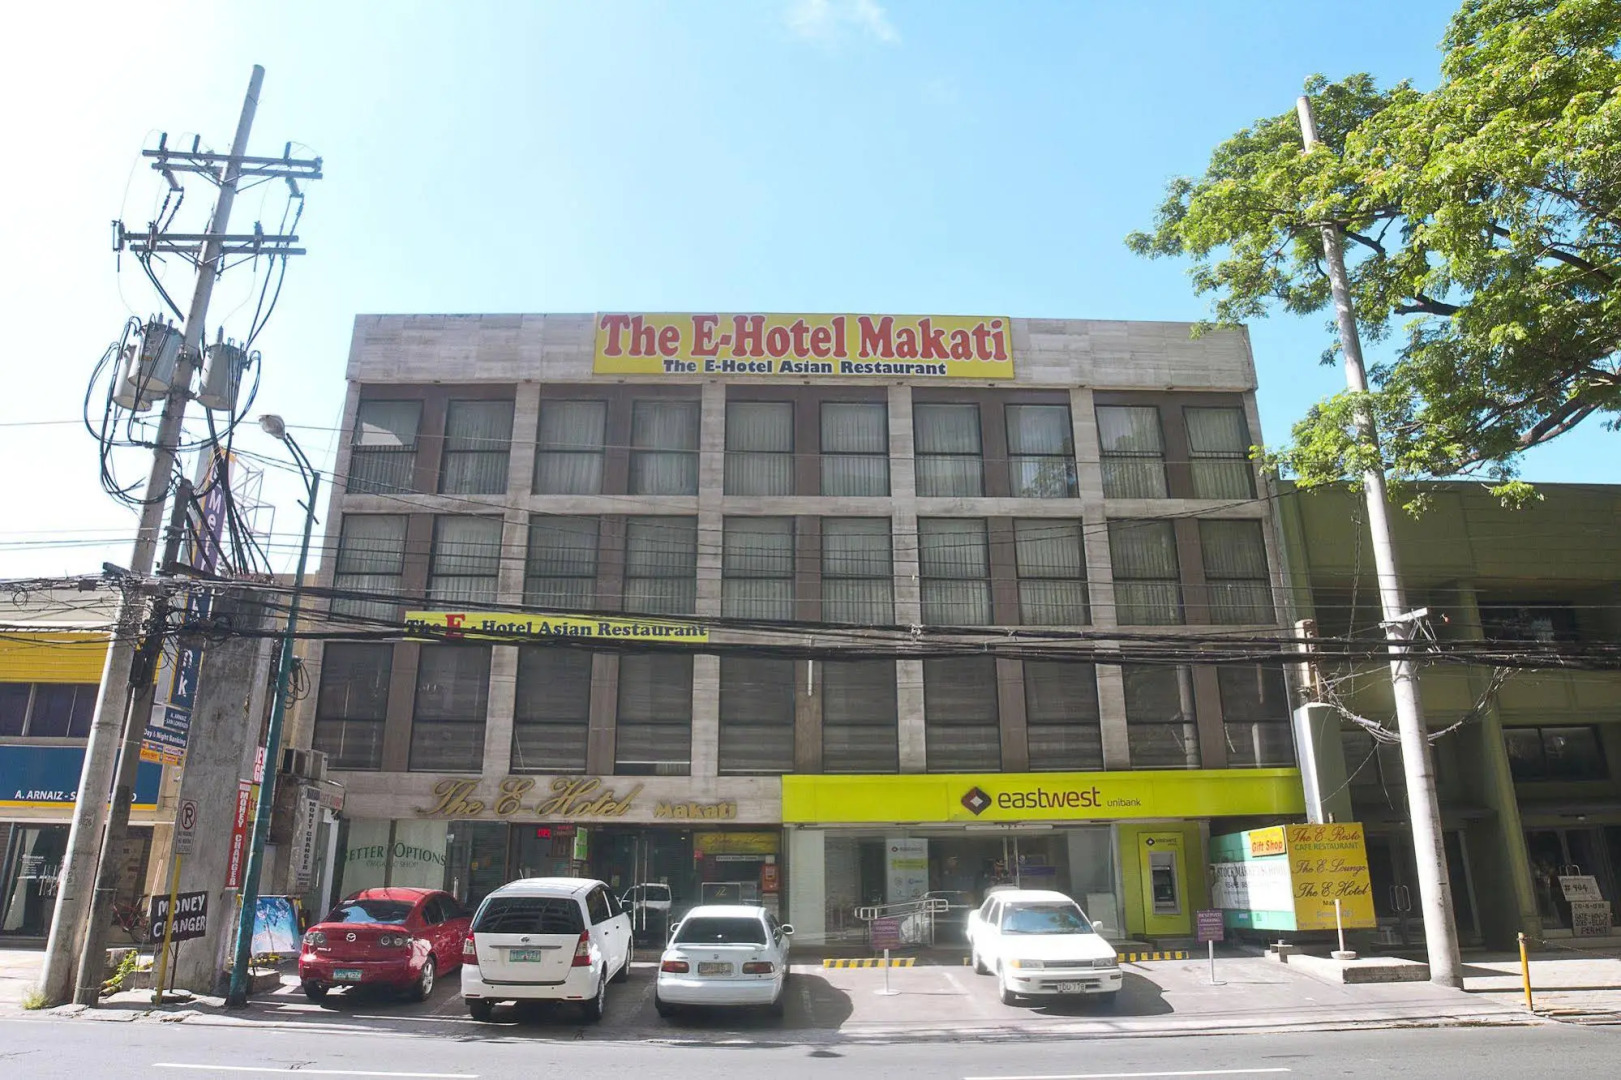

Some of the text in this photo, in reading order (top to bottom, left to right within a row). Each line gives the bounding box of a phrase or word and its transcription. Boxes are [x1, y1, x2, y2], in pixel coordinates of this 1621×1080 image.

[601, 313, 1008, 361] The E-Hotel Makati
[663, 359, 947, 376] The E-Hotel Asian Restaurant
[404, 620, 441, 633] The
[537, 621, 593, 637] Asian
[597, 622, 708, 638] Restaurant
[143, 728, 153, 738] Day
[157, 730, 169, 742] Night
[169, 733, 187, 747] Banking
[14, 790, 25, 800] A.
[26, 790, 63, 800] ARNAIZ
[416, 777, 485, 817] The
[653, 801, 738, 819] Makati
[998, 786, 1142, 809] eastwest unibank
[237, 791, 249, 828] MONEY
[307, 801, 317, 830] MONEY
[1288, 827, 1312, 843] The
[302, 831, 313, 870] CHANGER
[345, 842, 447, 867] ETTER OPTIONS
[1252, 839, 1283, 853] Gift Shop
[1295, 842, 1359, 851] CAFE RESTAURANT
[229, 834, 243, 886] CHANGER
[1292, 859, 1314, 874] The
[1294, 882, 1318, 899] The
